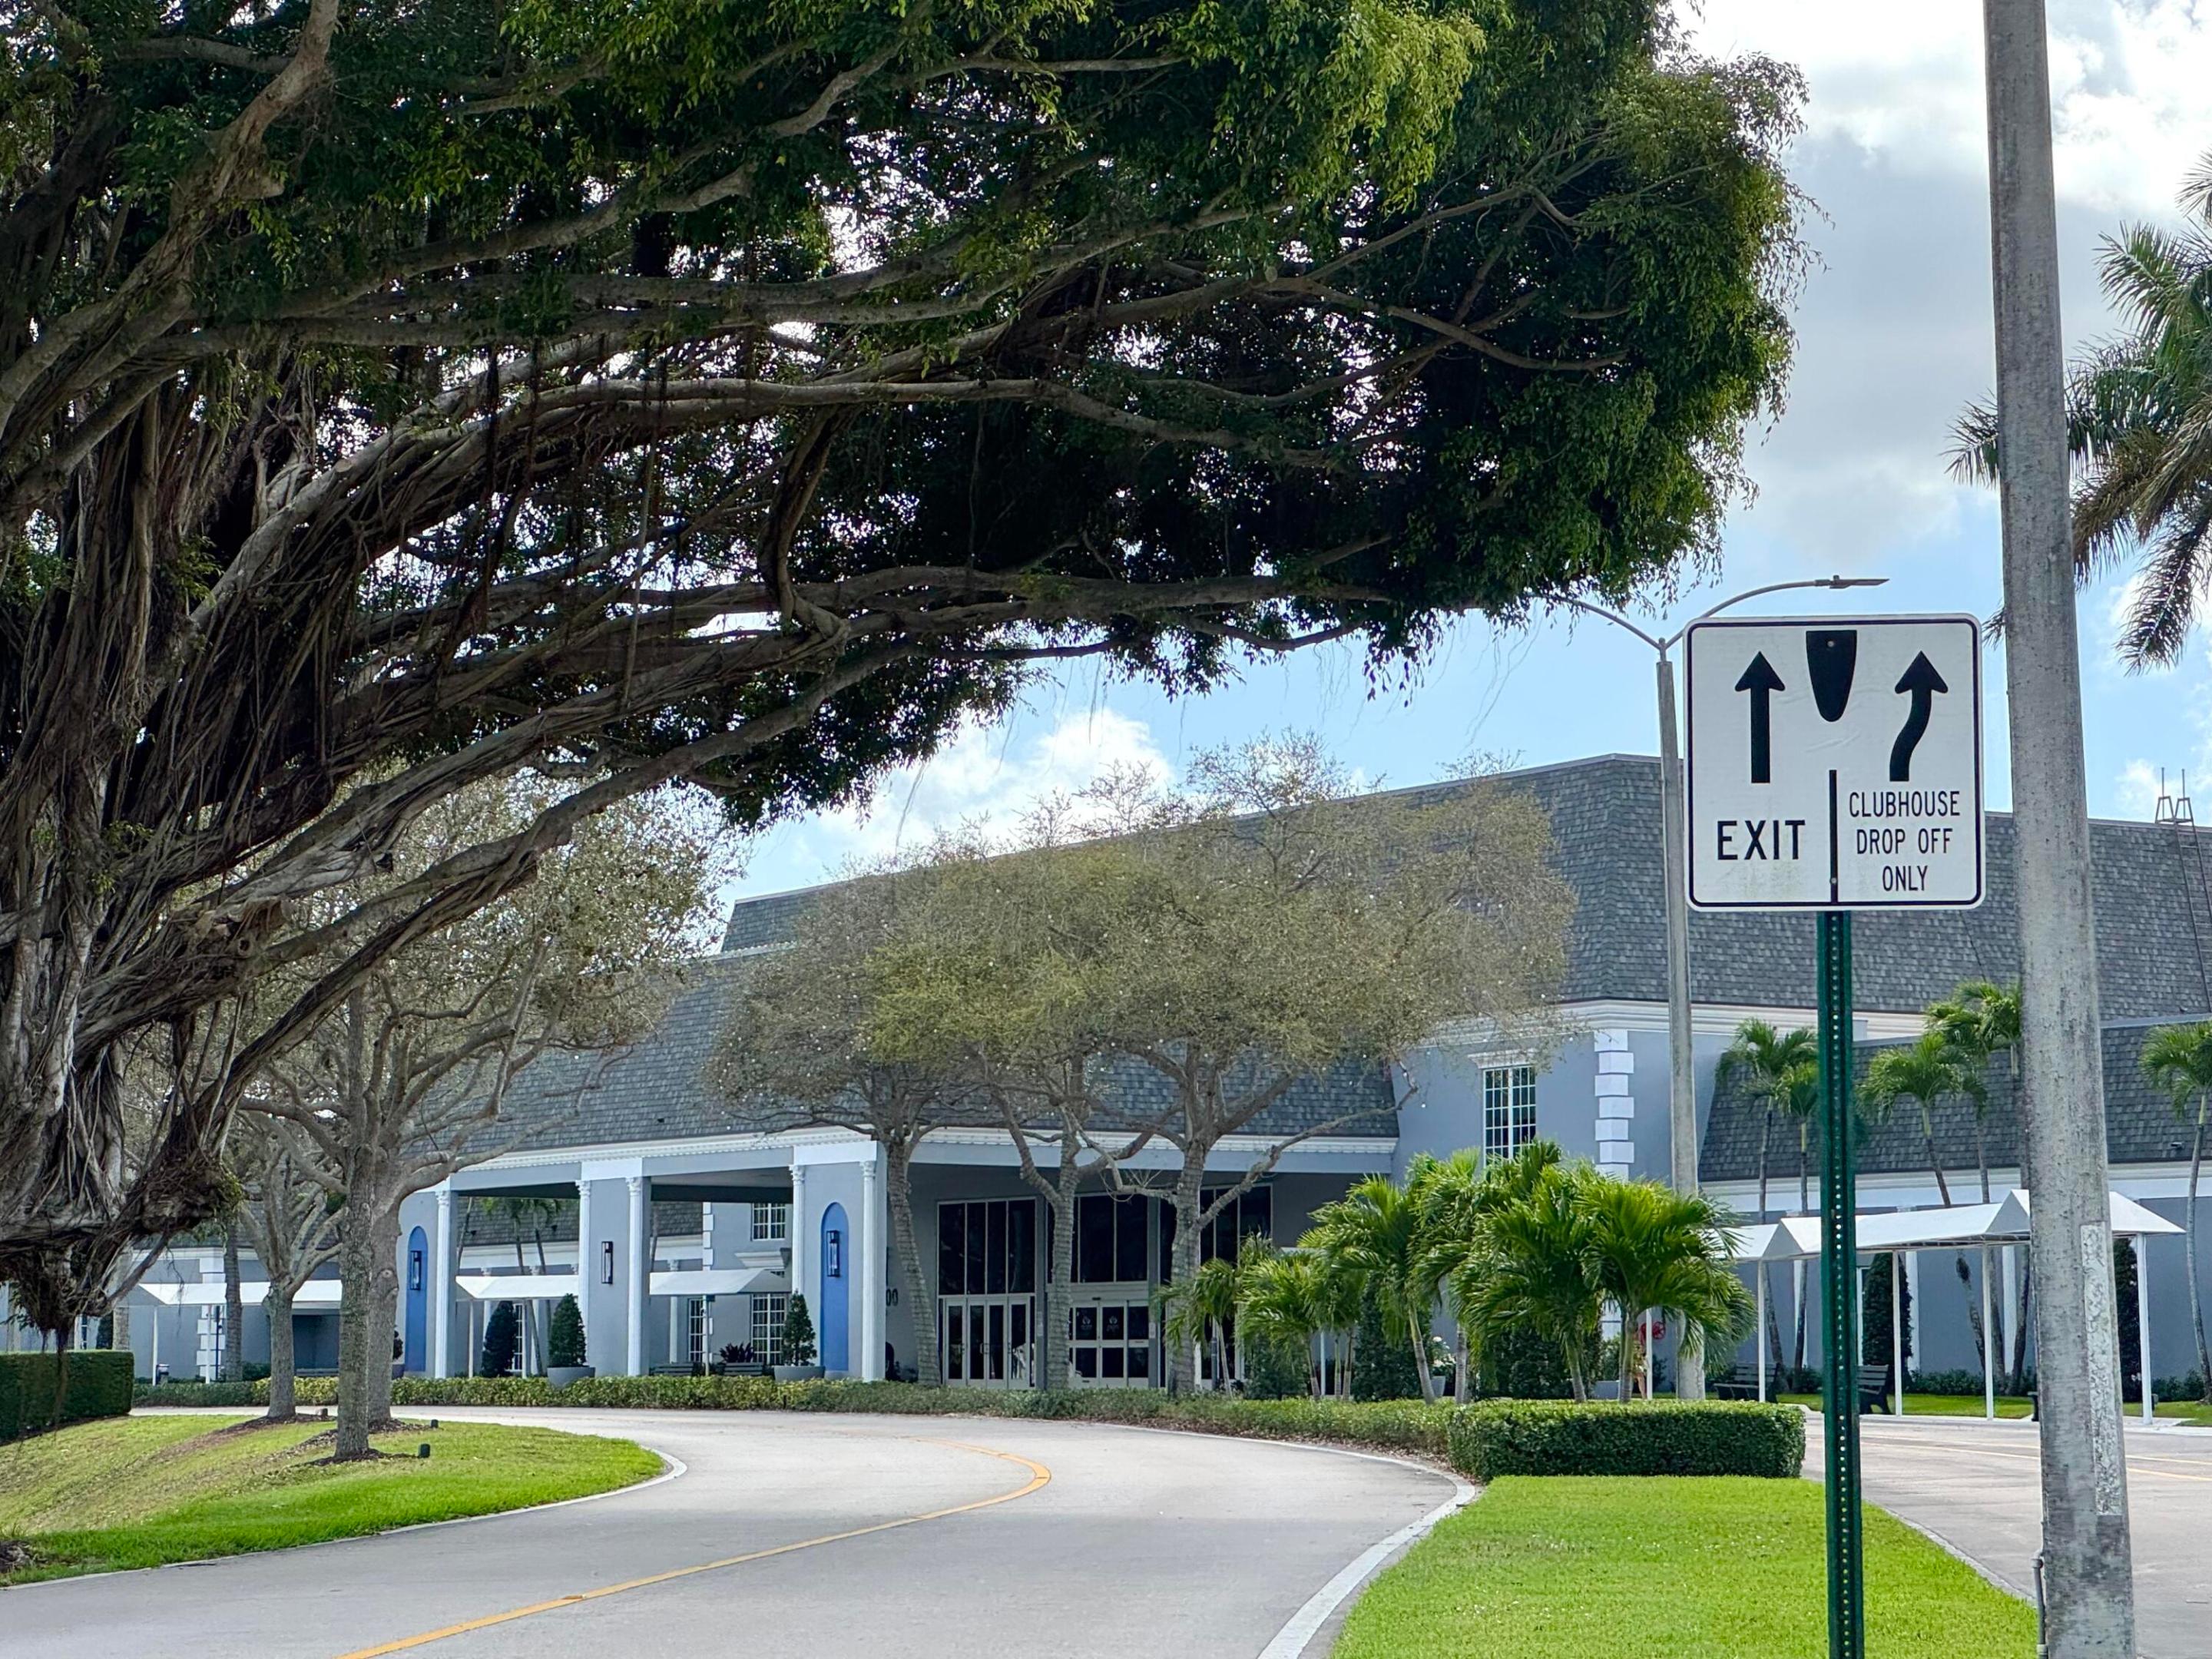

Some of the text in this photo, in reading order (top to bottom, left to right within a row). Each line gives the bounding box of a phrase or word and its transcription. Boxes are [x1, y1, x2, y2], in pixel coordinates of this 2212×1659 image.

[1849, 790, 1960, 818] CLUBHOUSE
[1717, 820, 1806, 860] EXIT
[1856, 828, 1953, 855] DROP OFF
[1882, 865, 1929, 892] ONLY
